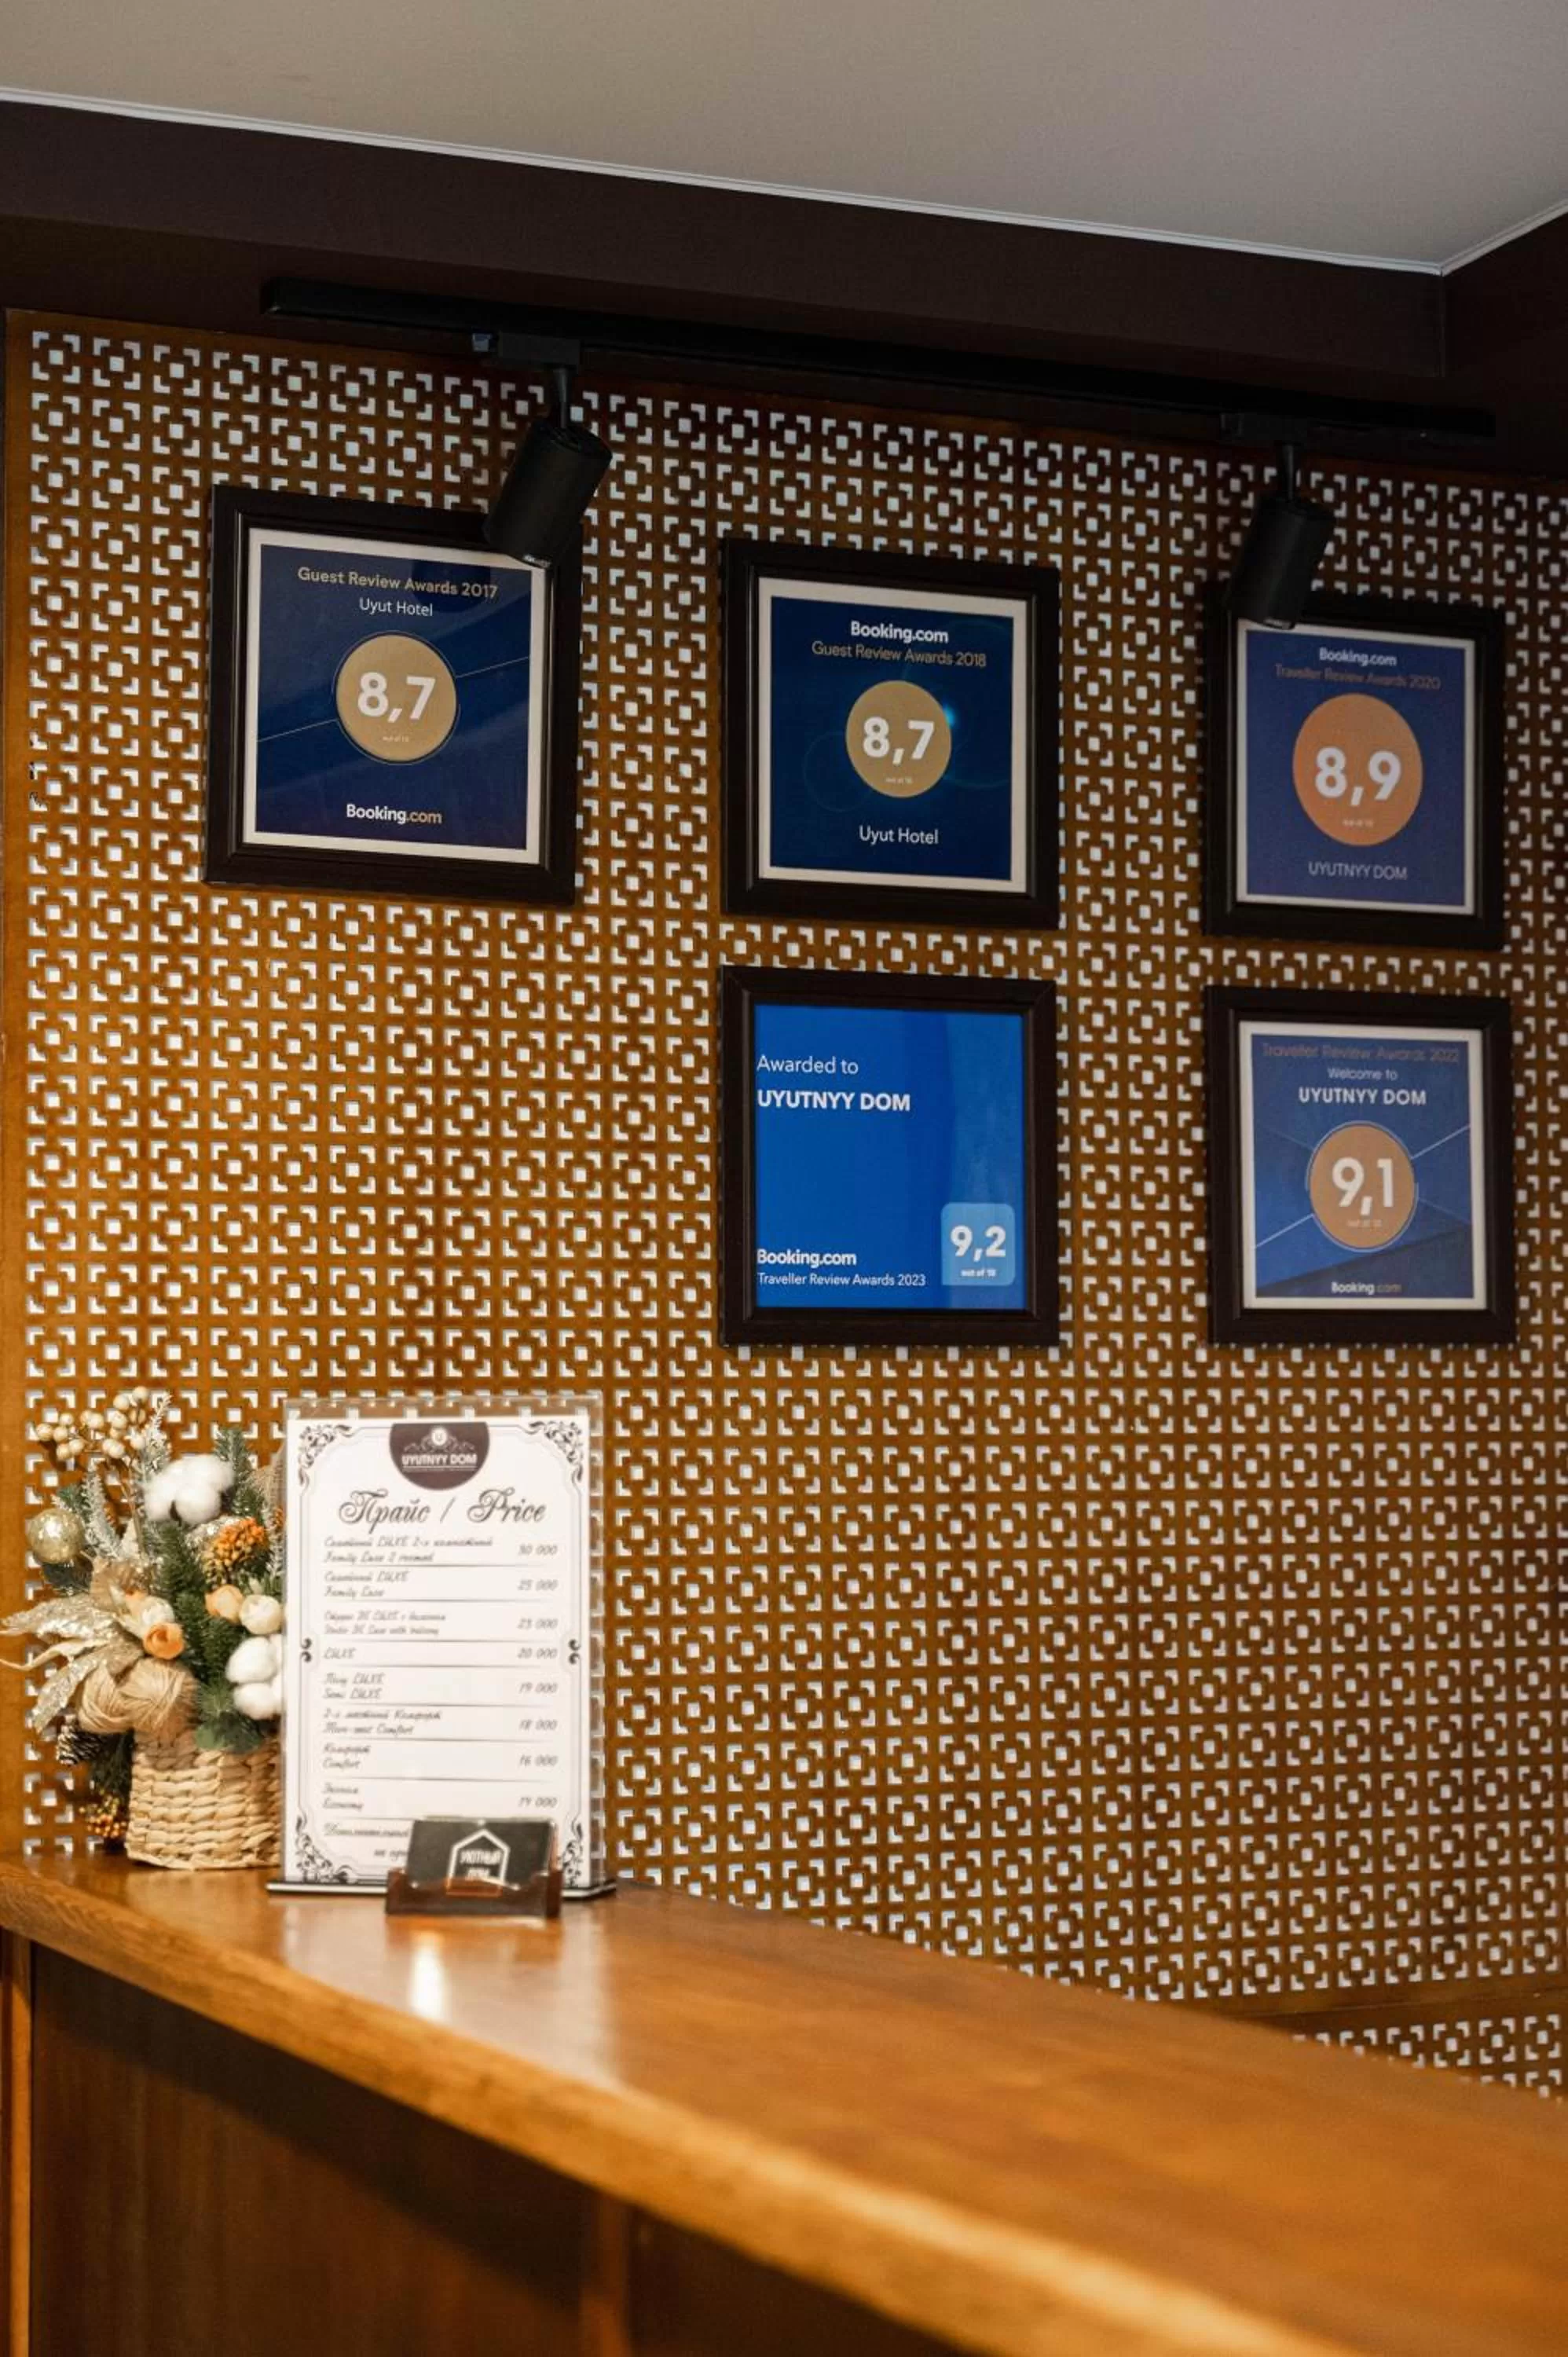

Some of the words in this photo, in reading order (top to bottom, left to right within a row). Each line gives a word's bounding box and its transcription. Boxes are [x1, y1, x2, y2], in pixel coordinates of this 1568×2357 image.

[298, 566, 345, 585] Guest
[348, 571, 401, 589] Review
[405, 576, 457, 596] Awards
[461, 581, 499, 599] 2017
[359, 597, 393, 616] Uyut
[397, 599, 434, 617] Hotel
[851, 621, 949, 644] Booking.com
[811, 641, 853, 658] Guest
[855, 644, 901, 662] Review
[904, 649, 953, 666] Awards
[955, 651, 987, 668] 2018
[1319, 647, 1397, 666] Booking.com
[357, 671, 436, 724] 8,7
[863, 716, 935, 765] 8,7
[1314, 746, 1401, 807] 8,9
[346, 803, 442, 825] Booking.com
[859, 825, 895, 845] Uyut
[898, 828, 939, 845] Hotel
[1308, 861, 1372, 878] UYUTNYY
[1373, 865, 1408, 881] DOM
[757, 1055, 837, 1074] Awarded
[841, 1058, 859, 1075] to
[1328, 1066, 1383, 1081] Welcome
[1386, 1067, 1398, 1081] to
[757, 1090, 855, 1110] UYUTNYY
[860, 1093, 911, 1112] DOM
[1299, 1087, 1378, 1104] UYUTNYY
[1383, 1089, 1427, 1105] DOM
[1332, 1157, 1394, 1216] 9,1
[950, 1225, 1006, 1262] 9,2
[757, 1248, 857, 1269] Booking.com
[757, 1272, 808, 1287] Traveller
[809, 1273, 849, 1287] Review
[852, 1273, 895, 1287] Awards
[897, 1274, 926, 1287] 2023
[1332, 1281, 1402, 1296] Booking.com
[450, 1453, 478, 1464] DOM
[339, 1488, 430, 1534] Прайс
[439, 1497, 456, 1523] /
[467, 1486, 547, 1524] Price
